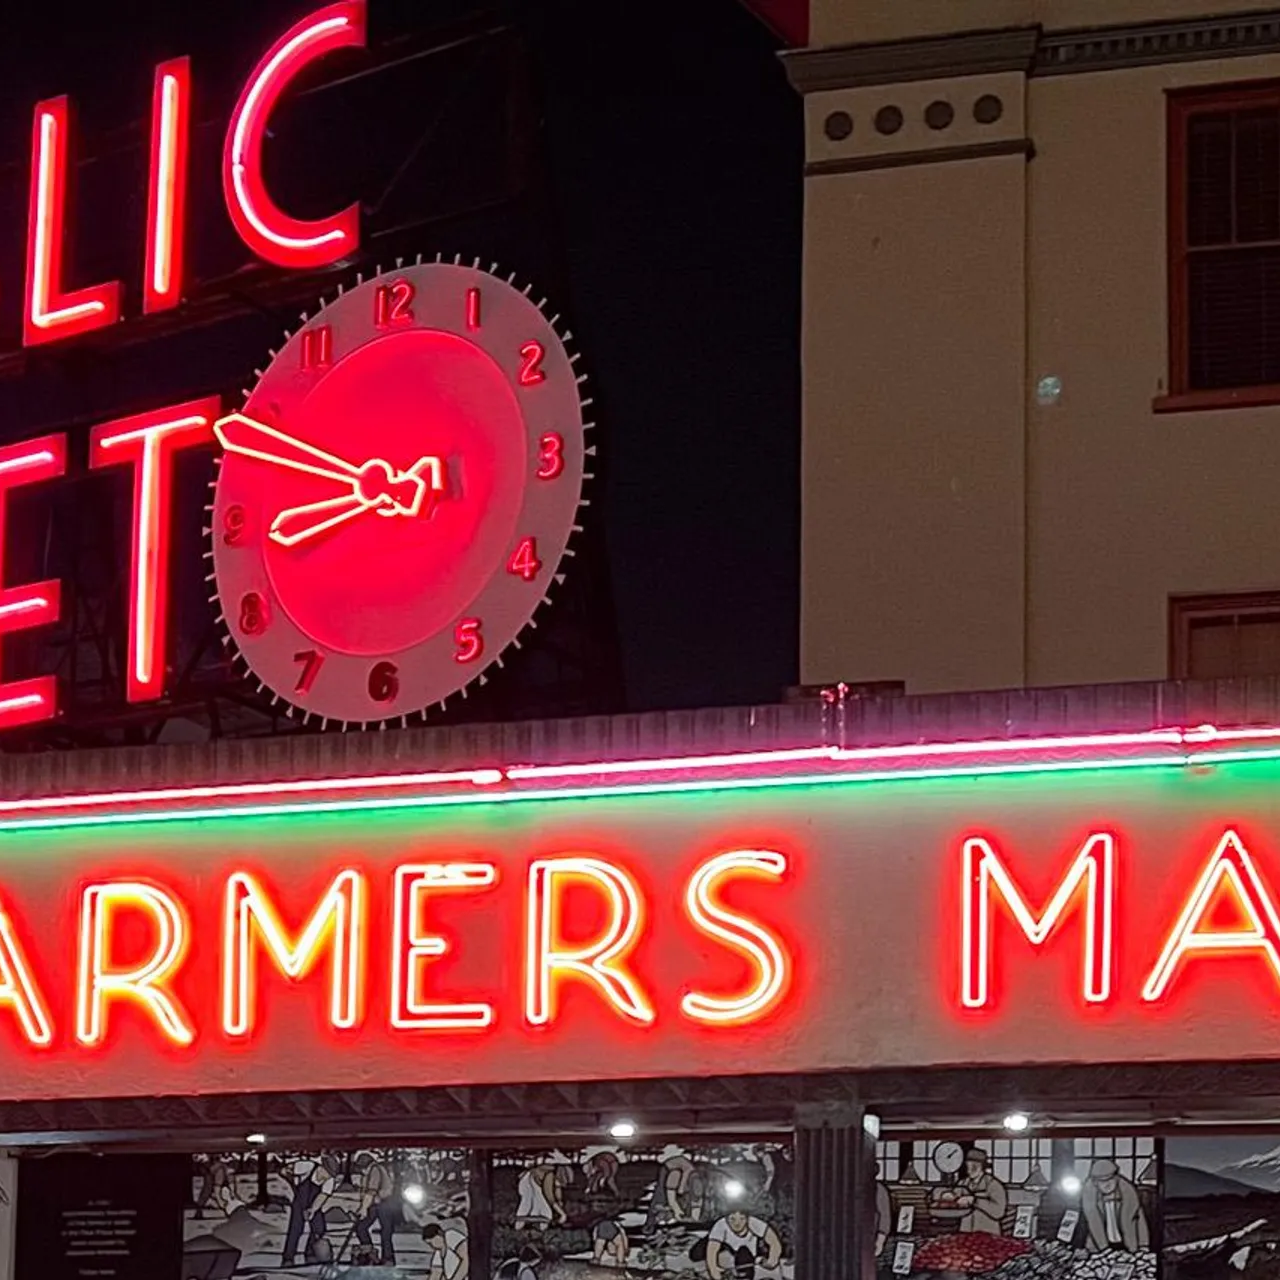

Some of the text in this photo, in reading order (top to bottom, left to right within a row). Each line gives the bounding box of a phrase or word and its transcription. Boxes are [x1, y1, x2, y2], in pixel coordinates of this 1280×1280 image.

[374, 278, 416, 330] 12
[465, 286, 482, 331] 1
[300, 324, 333, 369] 11
[520, 339, 546, 386] 2
[537, 432, 565, 479] 3
[223, 504, 248, 547] 9
[507, 536, 542, 581] 4
[239, 592, 271, 636] 8
[453, 617, 484, 664] 5
[293, 648, 325, 696] 7
[368, 661, 401, 705] 6
